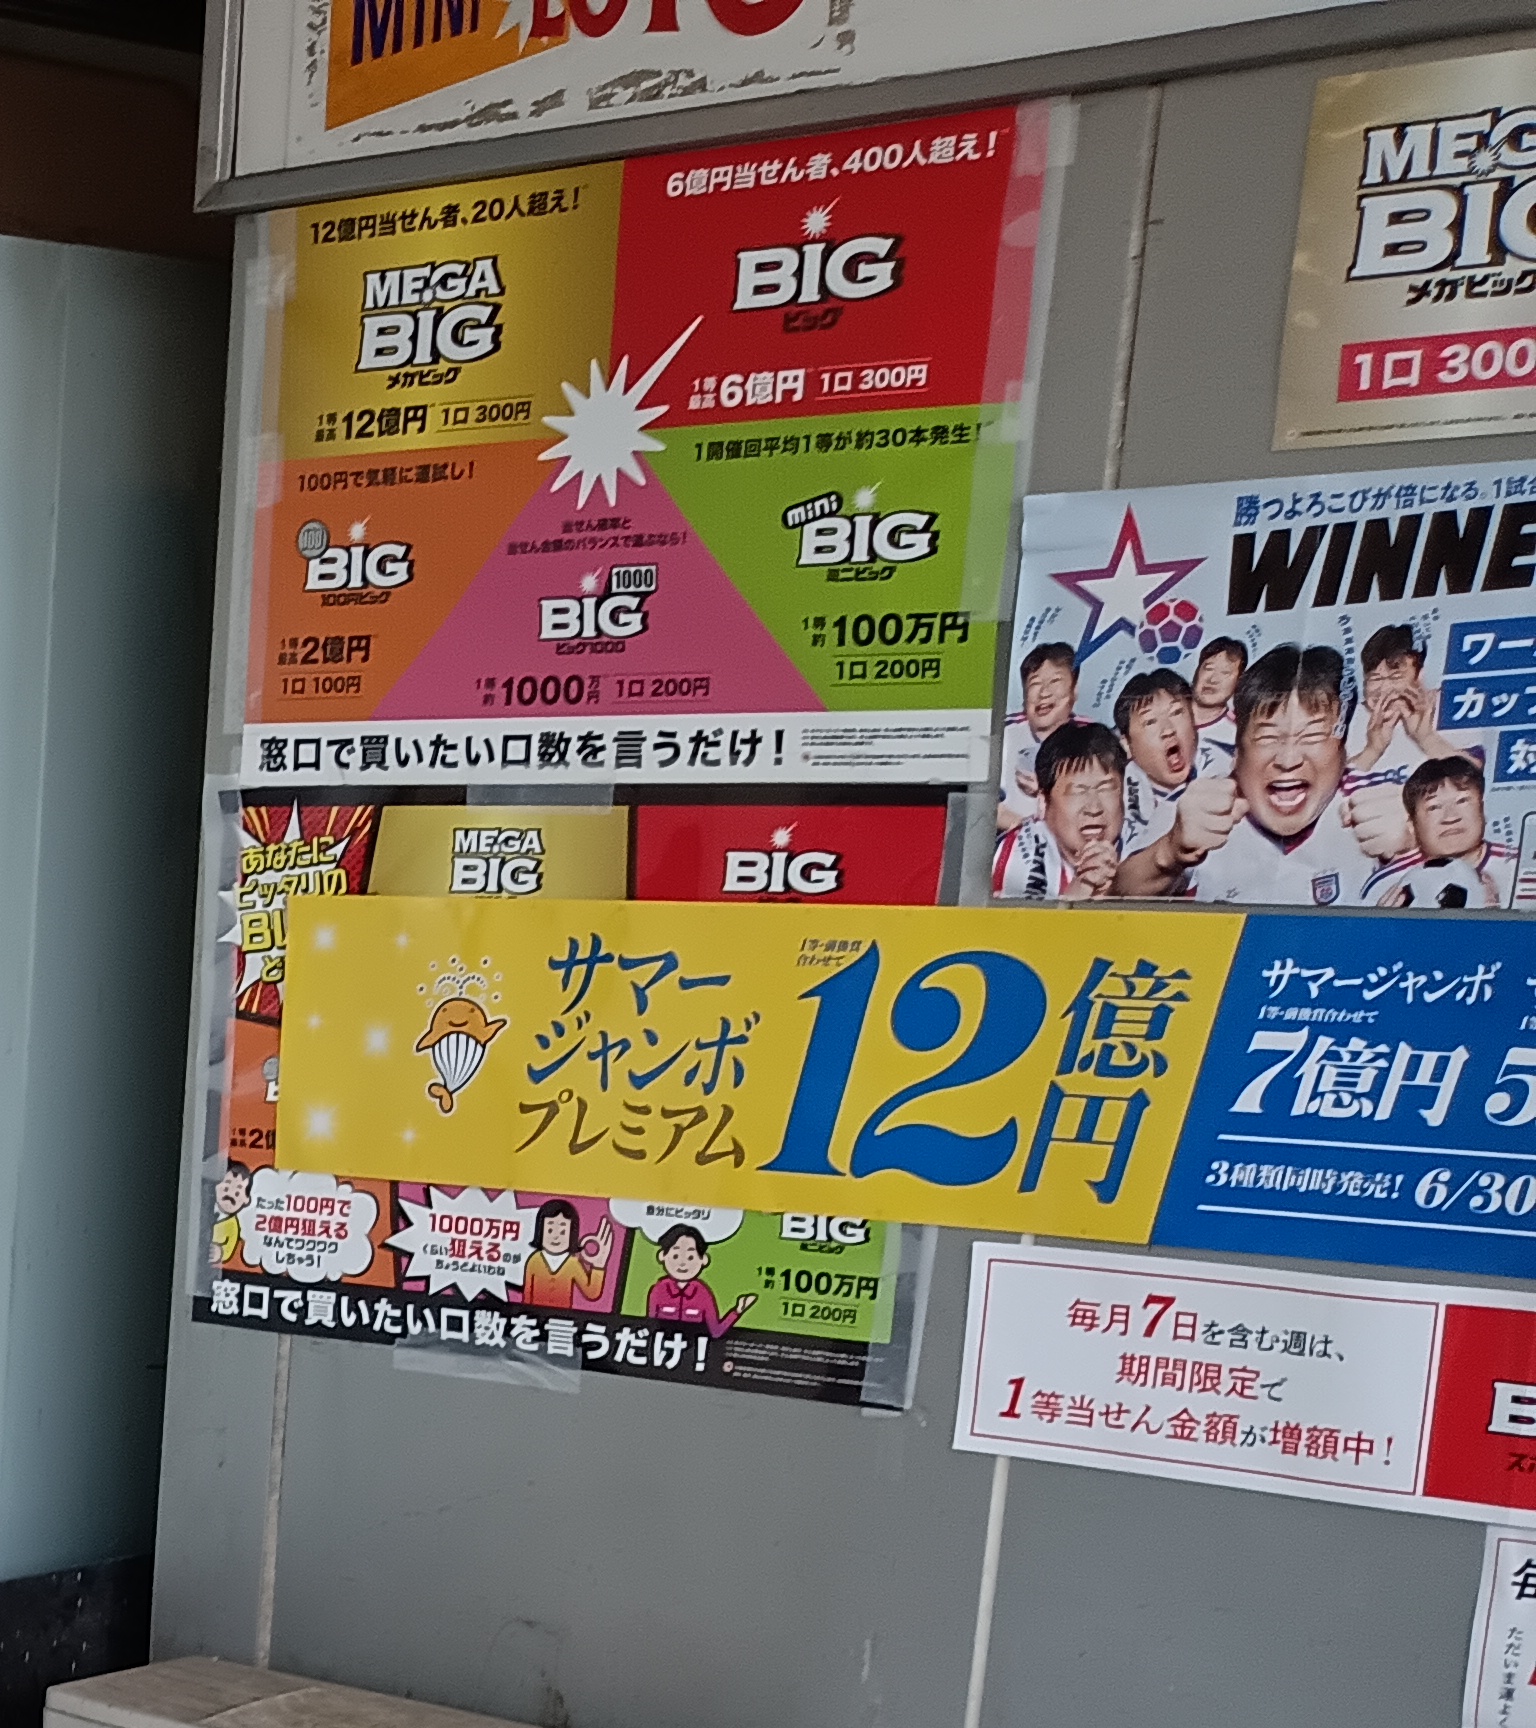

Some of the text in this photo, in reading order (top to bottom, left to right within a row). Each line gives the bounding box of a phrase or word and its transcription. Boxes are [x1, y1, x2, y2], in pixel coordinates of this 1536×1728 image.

[362, 256, 505, 311] MEGA
[732, 235, 901, 312] BIG
[355, 302, 503, 372] BIG
[859, 364, 927, 389] 300円
[1354, 350, 1423, 391] 1口
[342, 404, 428, 440] 12億円
[475, 401, 532, 422] 300円
[785, 493, 839, 527] mini
[798, 511, 938, 566] BIG
[304, 541, 414, 592] BIG
[614, 568, 654, 588] 1000
[538, 595, 649, 640] BIG
[833, 611, 971, 647] 100万円
[300, 634, 371, 665] 2億円
[835, 658, 941, 680] 1口 200円
[313, 675, 361, 693] 100円
[651, 677, 710, 697] 200円
[259, 728, 785, 772] 窓口で買いたい口数を言うだけ！
[242, 836, 337, 874] あなたに
[452, 828, 544, 855] MEGA
[449, 856, 543, 895] BIG
[722, 849, 843, 895] BIG
[548, 932, 732, 1016] サマー
[1262, 957, 1502, 1006] サマージャンボ
[527, 1011, 761, 1096] ジャンボ
[1228, 1025, 1470, 1127] 7億円
[514, 1088, 746, 1168] プレミアム
[429, 1213, 520, 1241] 1000万円
[780, 1213, 871, 1245] BIG
[780, 1268, 879, 1300] 100万円
[210, 1278, 709, 1373] 窓口で買いたい口数を言うだけ！
[809, 1305, 857, 1324] 200円
[1068, 1294, 1346, 1362] 毎月7日を含む週は、
[1115, 1353, 1285, 1403] 期間限定で
[998, 1376, 1395, 1466] 1等当せん金額が増額中！
